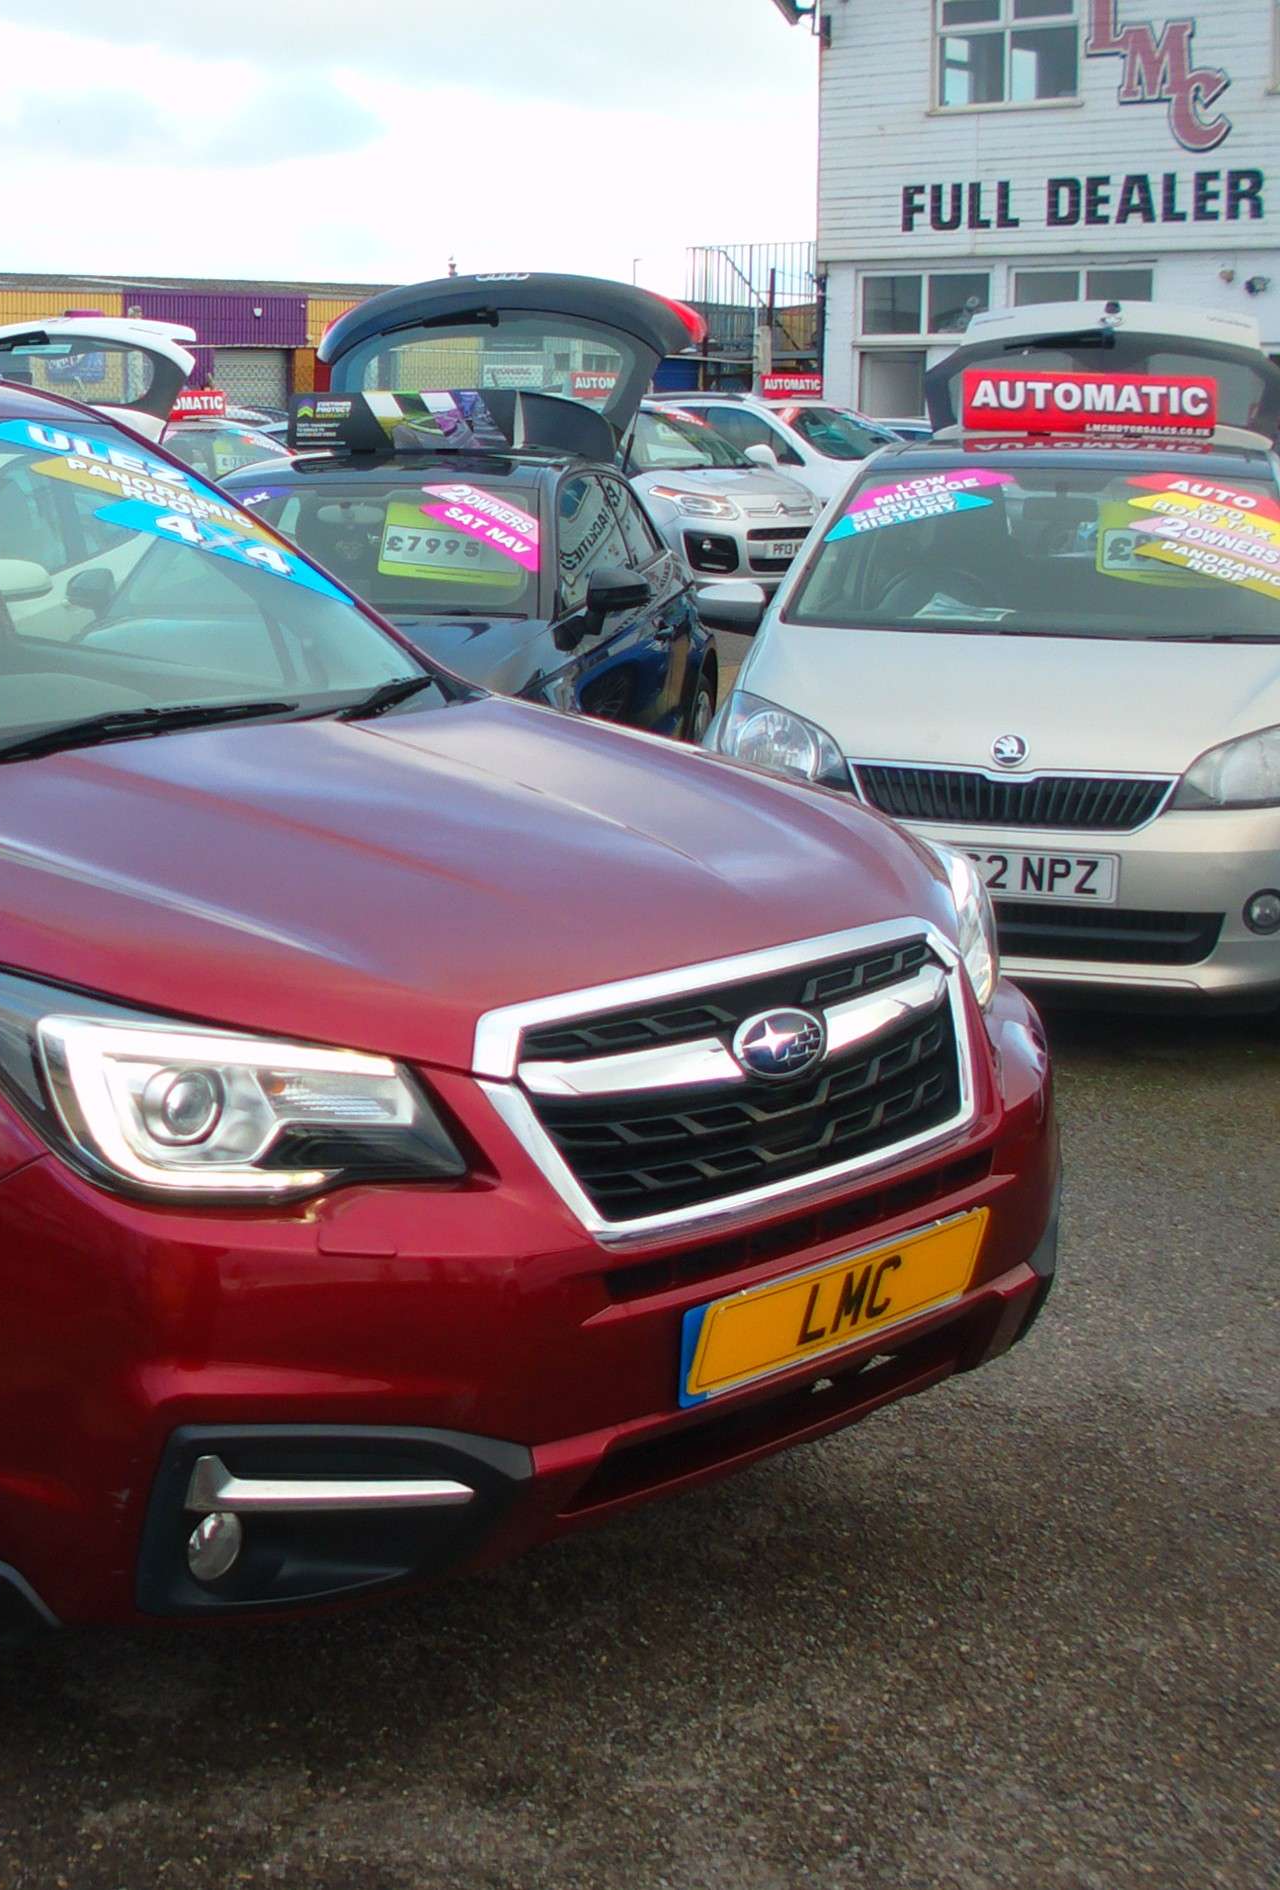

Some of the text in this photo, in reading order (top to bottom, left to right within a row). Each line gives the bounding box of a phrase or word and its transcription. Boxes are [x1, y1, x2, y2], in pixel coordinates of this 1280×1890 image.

[901, 169, 1265, 232] FULL DEALER
[575, 377, 616, 389] AUTOM
[763, 379, 822, 390] AUTOMATIC
[971, 380, 1209, 416] AUTOMATIC
[27, 426, 194, 492] ULEZ
[67, 456, 255, 530] PANORAMIC
[873, 478, 980, 507] MILEAGE
[896, 476, 946, 492] LOW
[1167, 480, 1257, 508] AUTO
[120, 484, 211, 521] ROOF
[852, 493, 953, 520] SERVICE
[853, 502, 957, 532] HISTORY
[1152, 500, 1276, 541] ROAD TAX
[387, 535, 481, 558] £7995
[444, 507, 532, 554] SAT NAV
[1161, 541, 1280, 586] PANORAMIC
[1186, 559, 1249, 582] ROOF
[1021, 856, 1100, 894] NPZ
[796, 1255, 902, 1347] LMC
